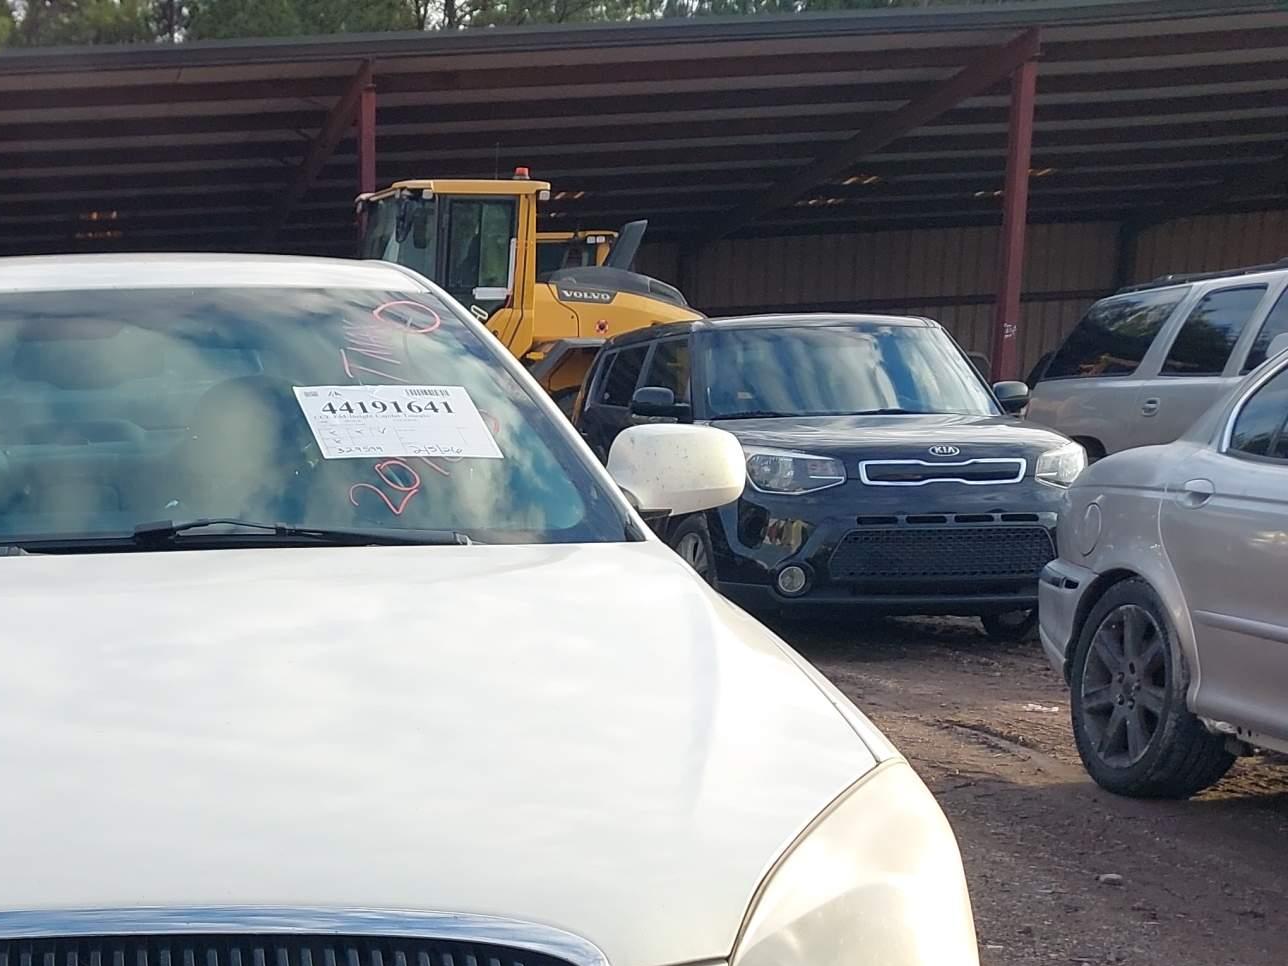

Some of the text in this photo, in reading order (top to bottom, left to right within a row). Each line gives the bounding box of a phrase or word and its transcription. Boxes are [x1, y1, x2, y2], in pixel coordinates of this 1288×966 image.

[561, 290, 611, 300] VOLVO
[321, 400, 456, 414] 44191641
[933, 445, 957, 455] KIA
